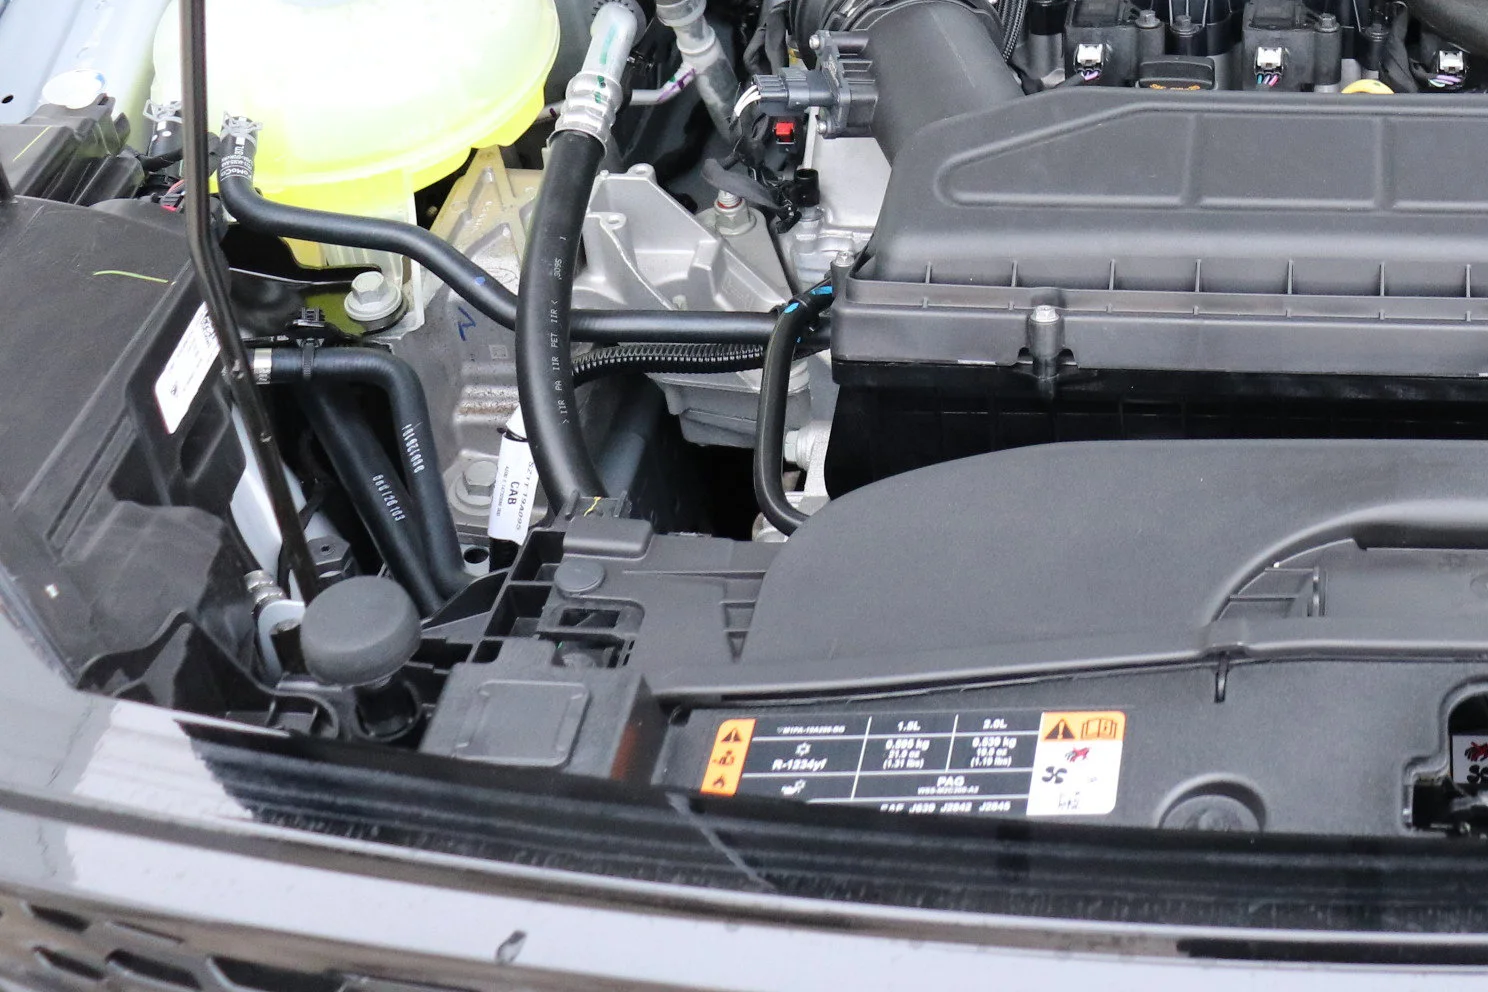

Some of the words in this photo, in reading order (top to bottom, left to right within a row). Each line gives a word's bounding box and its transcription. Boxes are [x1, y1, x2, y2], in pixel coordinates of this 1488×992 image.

[507, 481, 520, 505] CAB
[916, 739, 930, 751] kg
[1002, 736, 1017, 749] kg
[772, 758, 828, 772] R-1234yf
[936, 776, 965, 786] PAG
